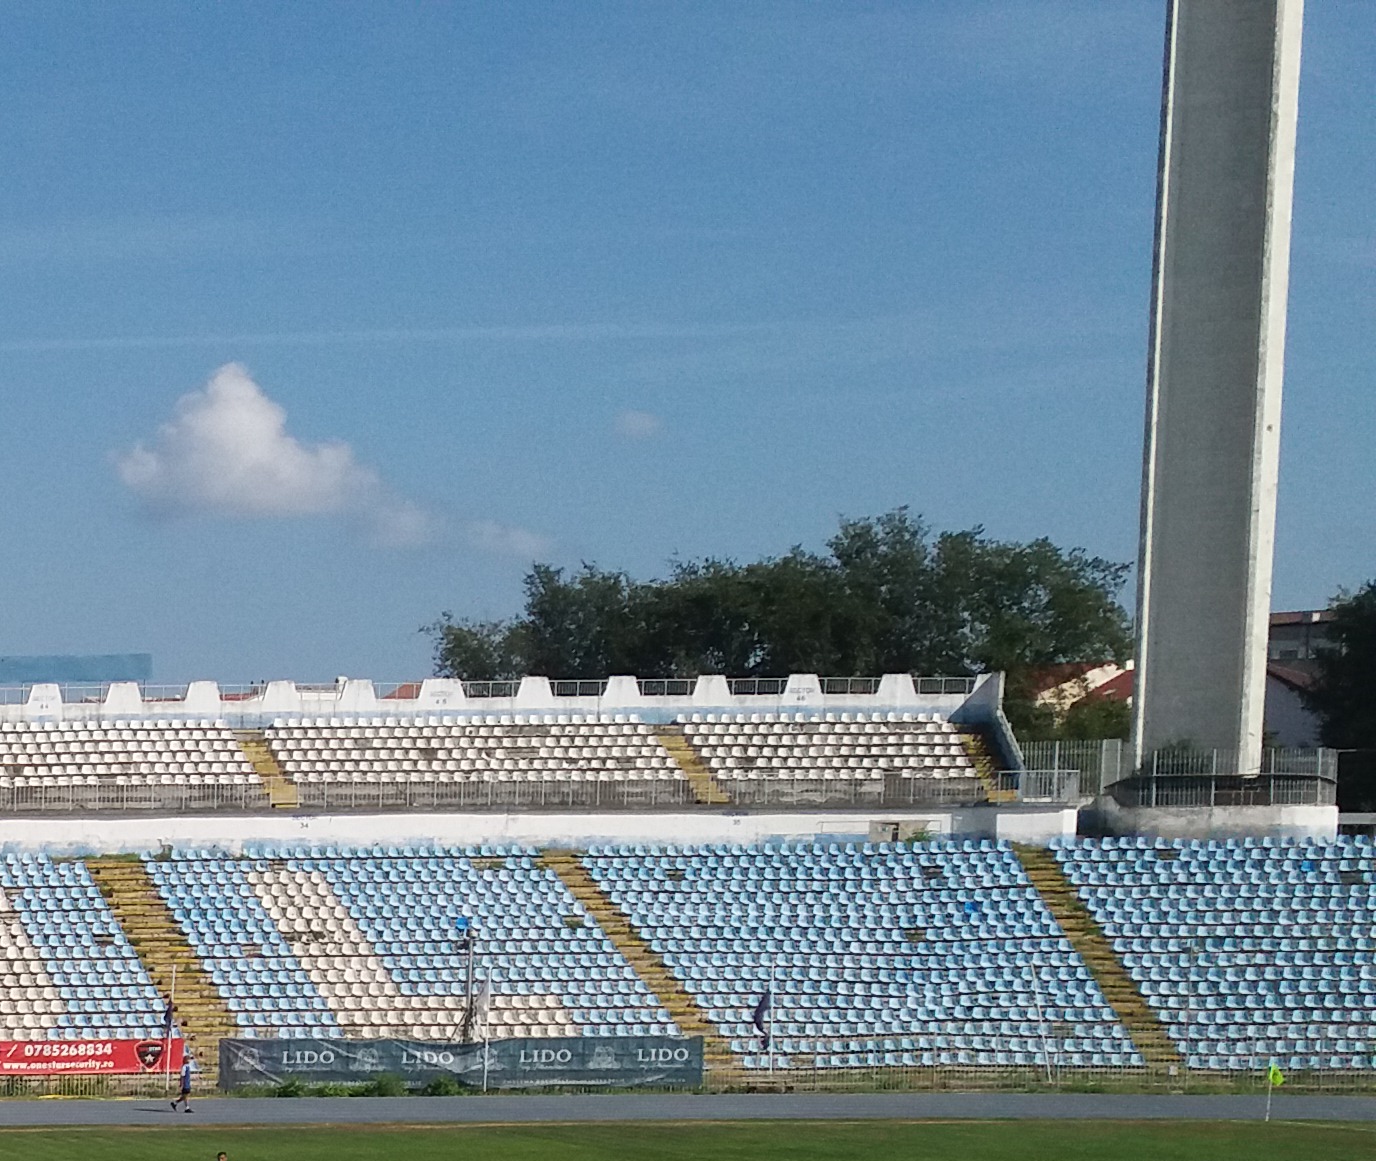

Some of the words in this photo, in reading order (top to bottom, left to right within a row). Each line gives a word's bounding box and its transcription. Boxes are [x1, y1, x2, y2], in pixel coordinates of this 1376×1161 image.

[282, 1050, 335, 1064] LIDO
[401, 1051, 454, 1065] LIDO
[519, 1049, 572, 1063] LIDO
[637, 1048, 689, 1061] LIDO
[3, 1059, 114, 1070] www.onestarsecurity.ro
